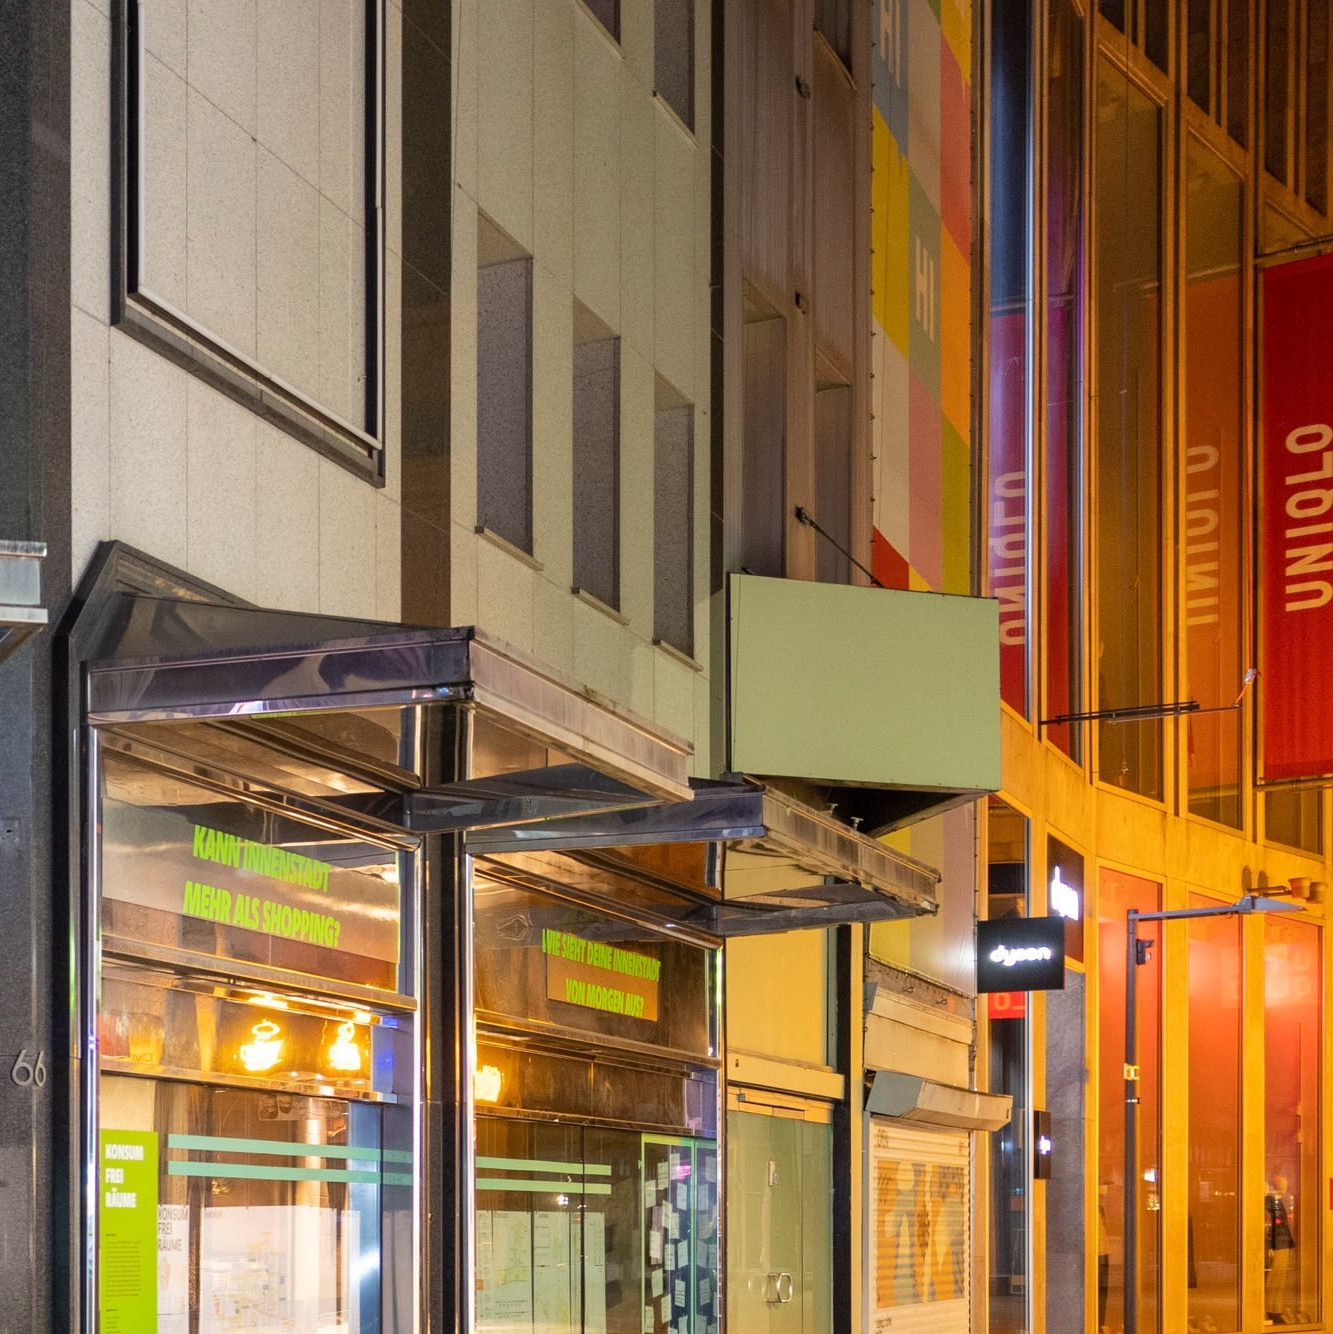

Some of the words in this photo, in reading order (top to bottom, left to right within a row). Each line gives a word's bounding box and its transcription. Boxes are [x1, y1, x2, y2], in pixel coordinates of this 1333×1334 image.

[916, 236, 935, 344] HI
[1285, 423, 1333, 612] UNIQLO
[193, 824, 241, 868] KANN
[244, 839, 332, 892] INNENSTADT
[183, 880, 233, 924] MEHR
[233, 893, 261, 930] ALS
[263, 900, 341, 948] SHOPPING?
[542, 928, 561, 958] WIE
[561, 932, 587, 963] SIEHT
[587, 941, 613, 970] DEINE
[613, 948, 661, 983] INNENSTADT
[989, 945, 1053, 967] dyson
[566, 977, 586, 1006] VON
[586, 982, 625, 1015] MORGEN
[625, 992, 645, 1019] AUS?
[105, 1143, 144, 1160] KONSUM
[105, 1168, 124, 1184] FREI
[105, 1187, 137, 1208] RÄUME
